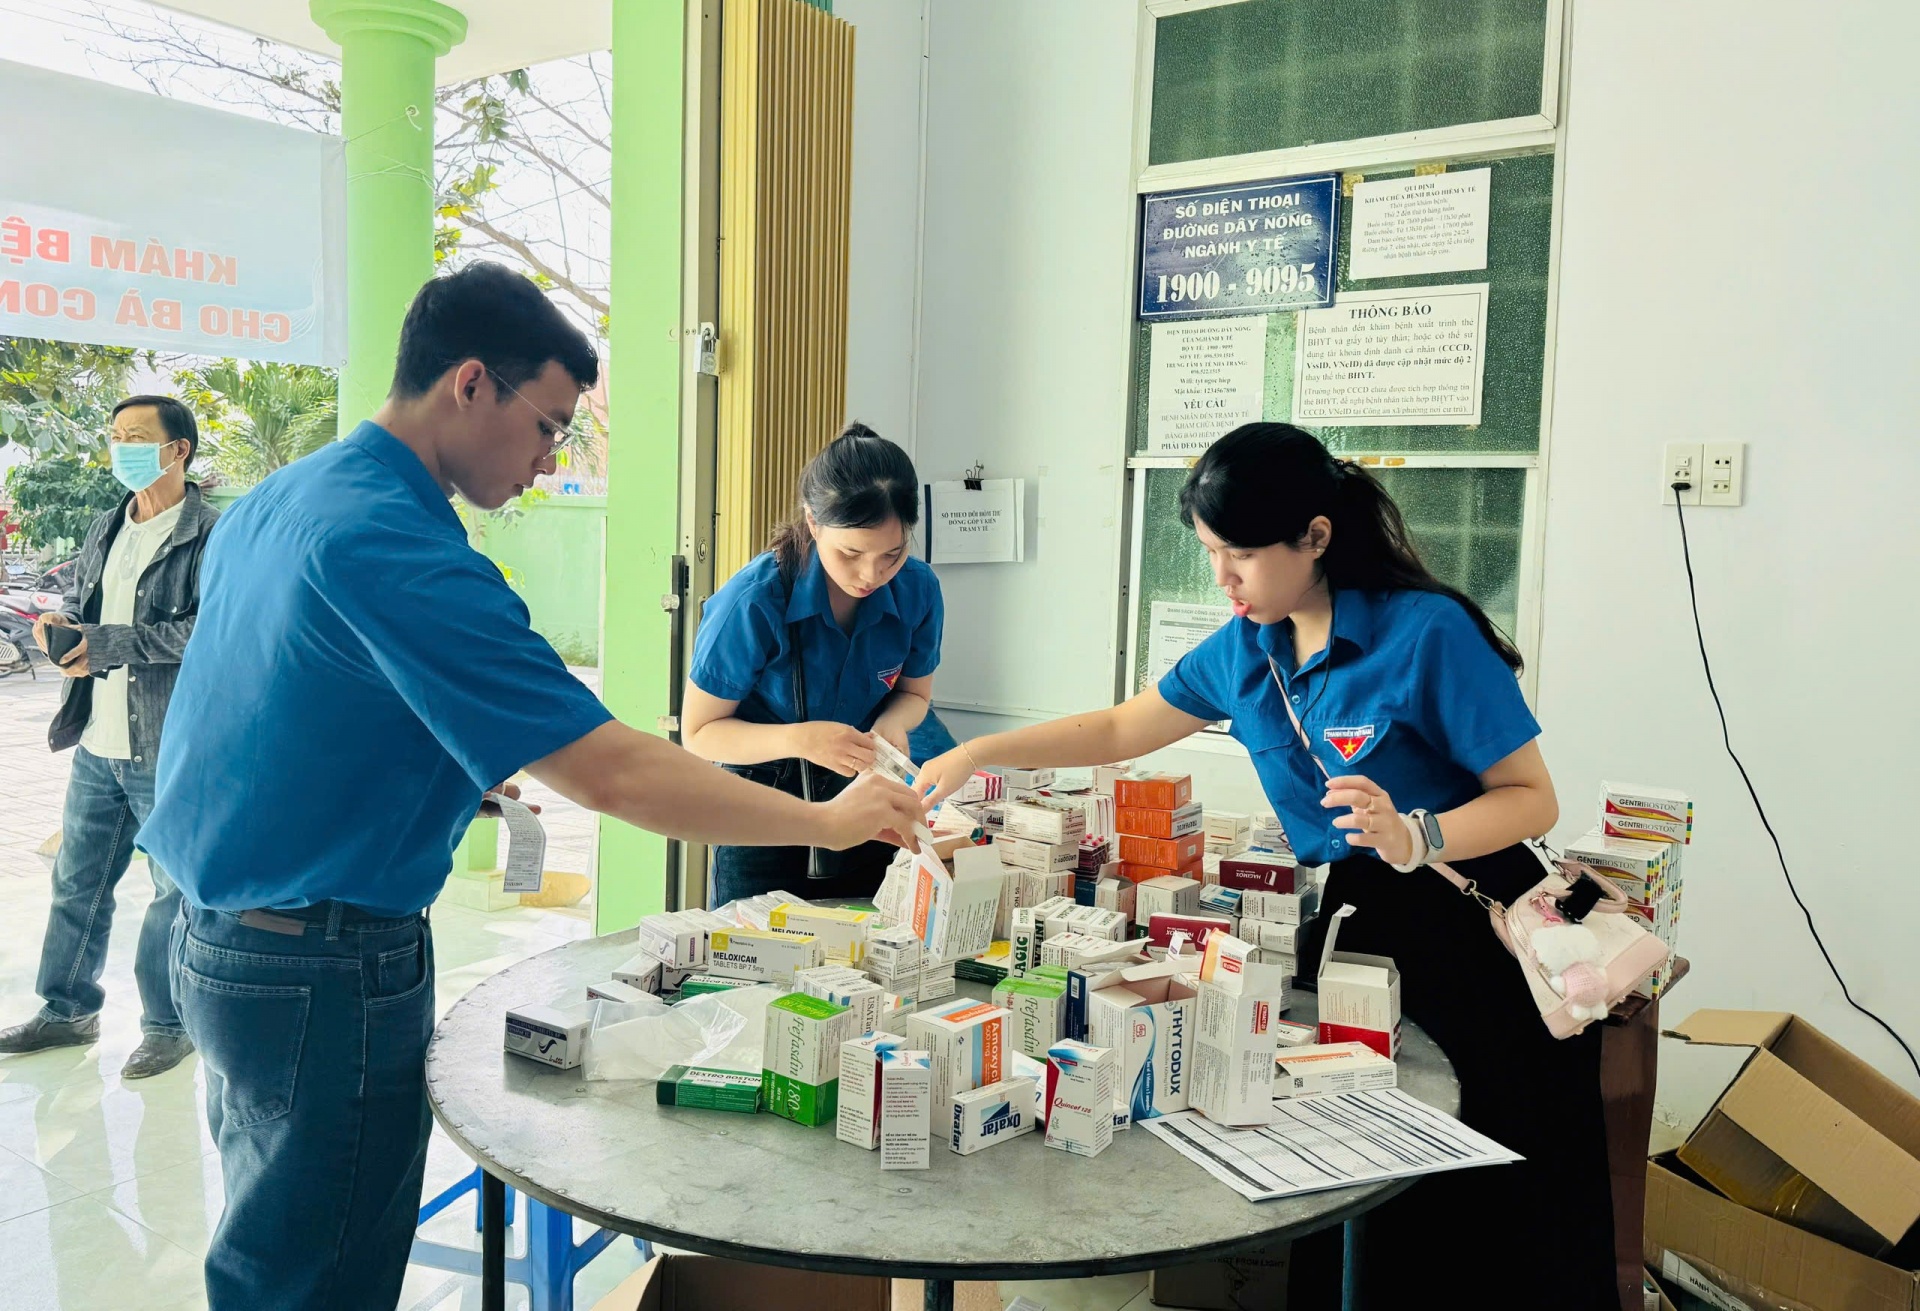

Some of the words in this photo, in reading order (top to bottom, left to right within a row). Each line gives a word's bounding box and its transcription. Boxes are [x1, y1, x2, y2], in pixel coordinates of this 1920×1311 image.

[1175, 200, 1198, 218] SỐ
[1203, 198, 1242, 216] ĐIỆN
[1248, 193, 1299, 210] THOẠI
[1163, 223, 1218, 240] ĐƯỜNG
[1224, 218, 1258, 234] DÂY
[1264, 213, 1312, 229] NÓNG
[1185, 241, 1240, 259] NGÀNH
[1244, 240, 1257, 252] Y
[1264, 232, 1287, 250] TẾ
[1156, 270, 1220, 303] 1900
[1245, 263, 1315, 296] 9095
[1349, 305, 1398, 319] THÔNG
[1403, 302, 1431, 316] BÁO
[1184, 400, 1204, 409] YÊU
[1206, 399, 1226, 409] CẦU
[1619, 798, 1676, 811] GENTRIBOSTON
[1618, 820, 1675, 833] GENTRIBOSTON
[1577, 856, 1636, 869] GENTRIBOSTON
[914, 875, 926, 931] Amoxycillin
[713, 952, 757, 964] MELOXICAM
[713, 960, 738, 970] TABLETS
[788, 1017, 805, 1077] Fefasdin
[990, 1022, 1000, 1082] Amoxyci
[1170, 1006, 1183, 1095] THYTODUX
[788, 1079, 801, 1111] 180
[1054, 1097, 1080, 1111] Quincef
[952, 1103, 962, 1151] Oxafar
[980, 1112, 1021, 1137] Oxafar
